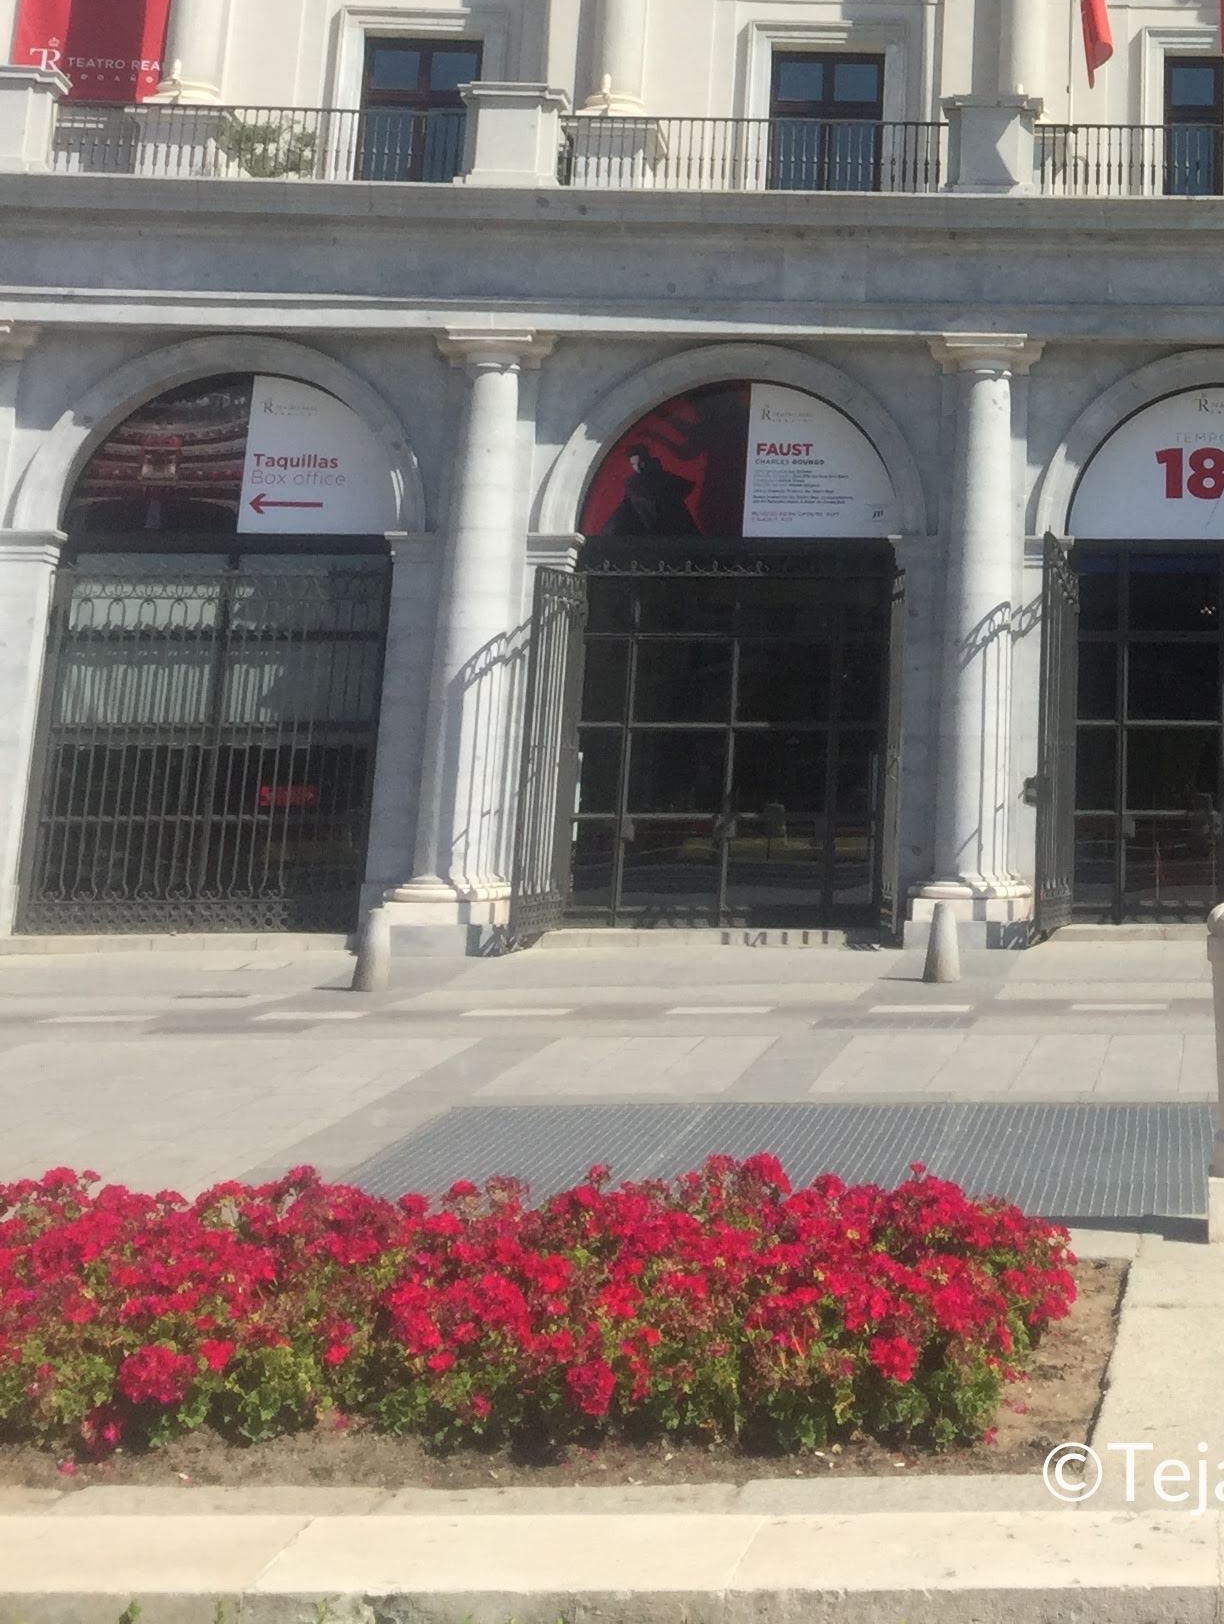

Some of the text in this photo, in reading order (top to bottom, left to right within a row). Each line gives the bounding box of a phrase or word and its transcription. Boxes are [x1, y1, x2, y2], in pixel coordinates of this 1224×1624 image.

[67, 57, 160, 71] TEATRO REA
[756, 442, 813, 456] FAUST
[253, 453, 339, 471] Taquillas
[251, 470, 346, 486] Box office
